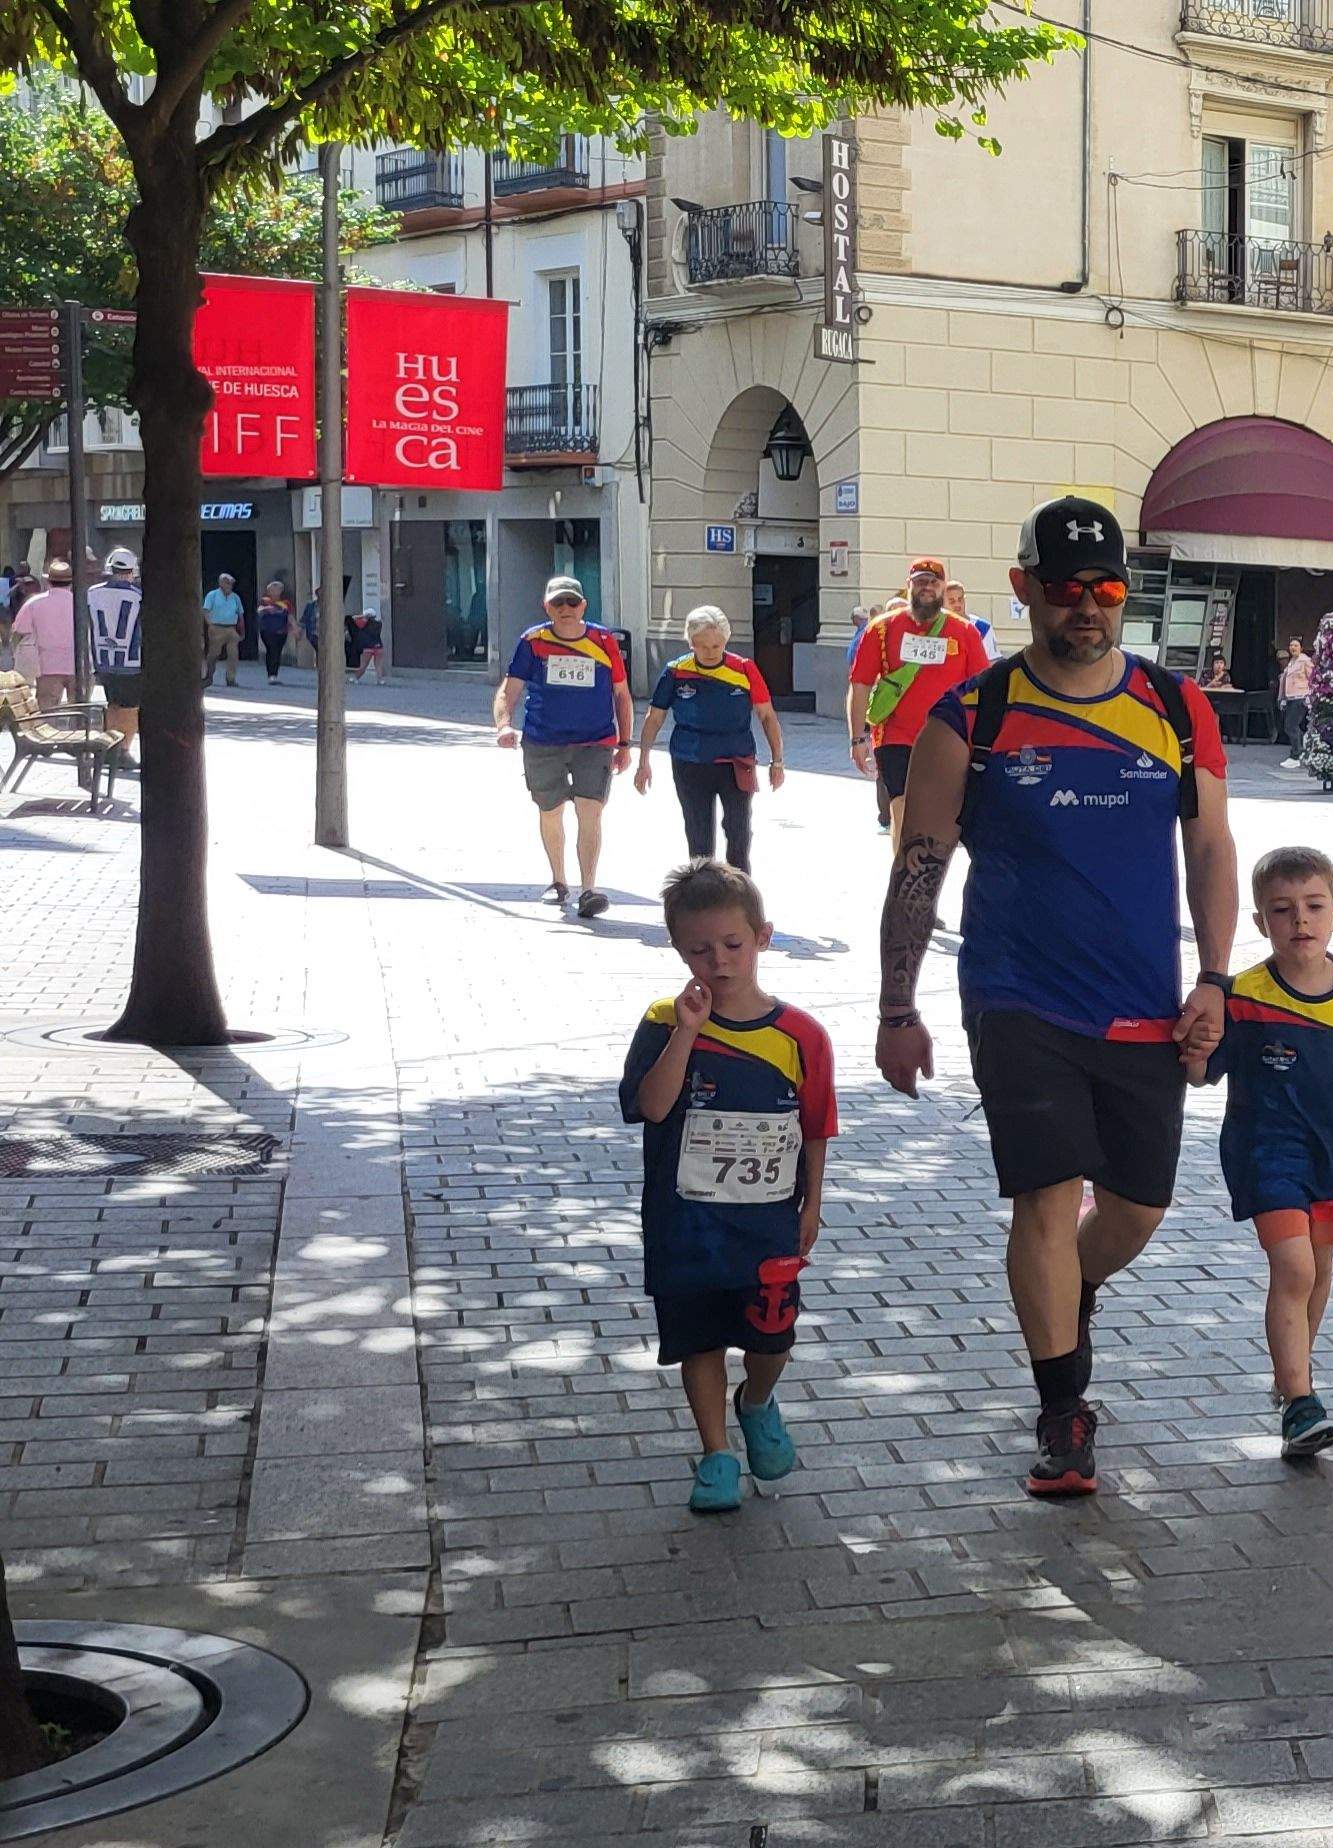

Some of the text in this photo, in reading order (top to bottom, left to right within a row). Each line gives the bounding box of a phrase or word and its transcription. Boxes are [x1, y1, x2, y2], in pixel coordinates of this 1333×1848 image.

[831, 139, 852, 324] HOSTAL
[216, 366, 298, 377] INTERNACIONAL
[223, 381, 242, 395] DE
[244, 383, 300, 399] HUESCA
[395, 383, 460, 422] es
[395, 435, 461, 470] ca
[200, 503, 252, 520] ECIMAS
[710, 528, 732, 543] HS
[558, 670, 584, 680] 616
[1120, 768, 1168, 780] Santander
[1083, 791, 1130, 808] mupol
[712, 1156, 782, 1185] 735
